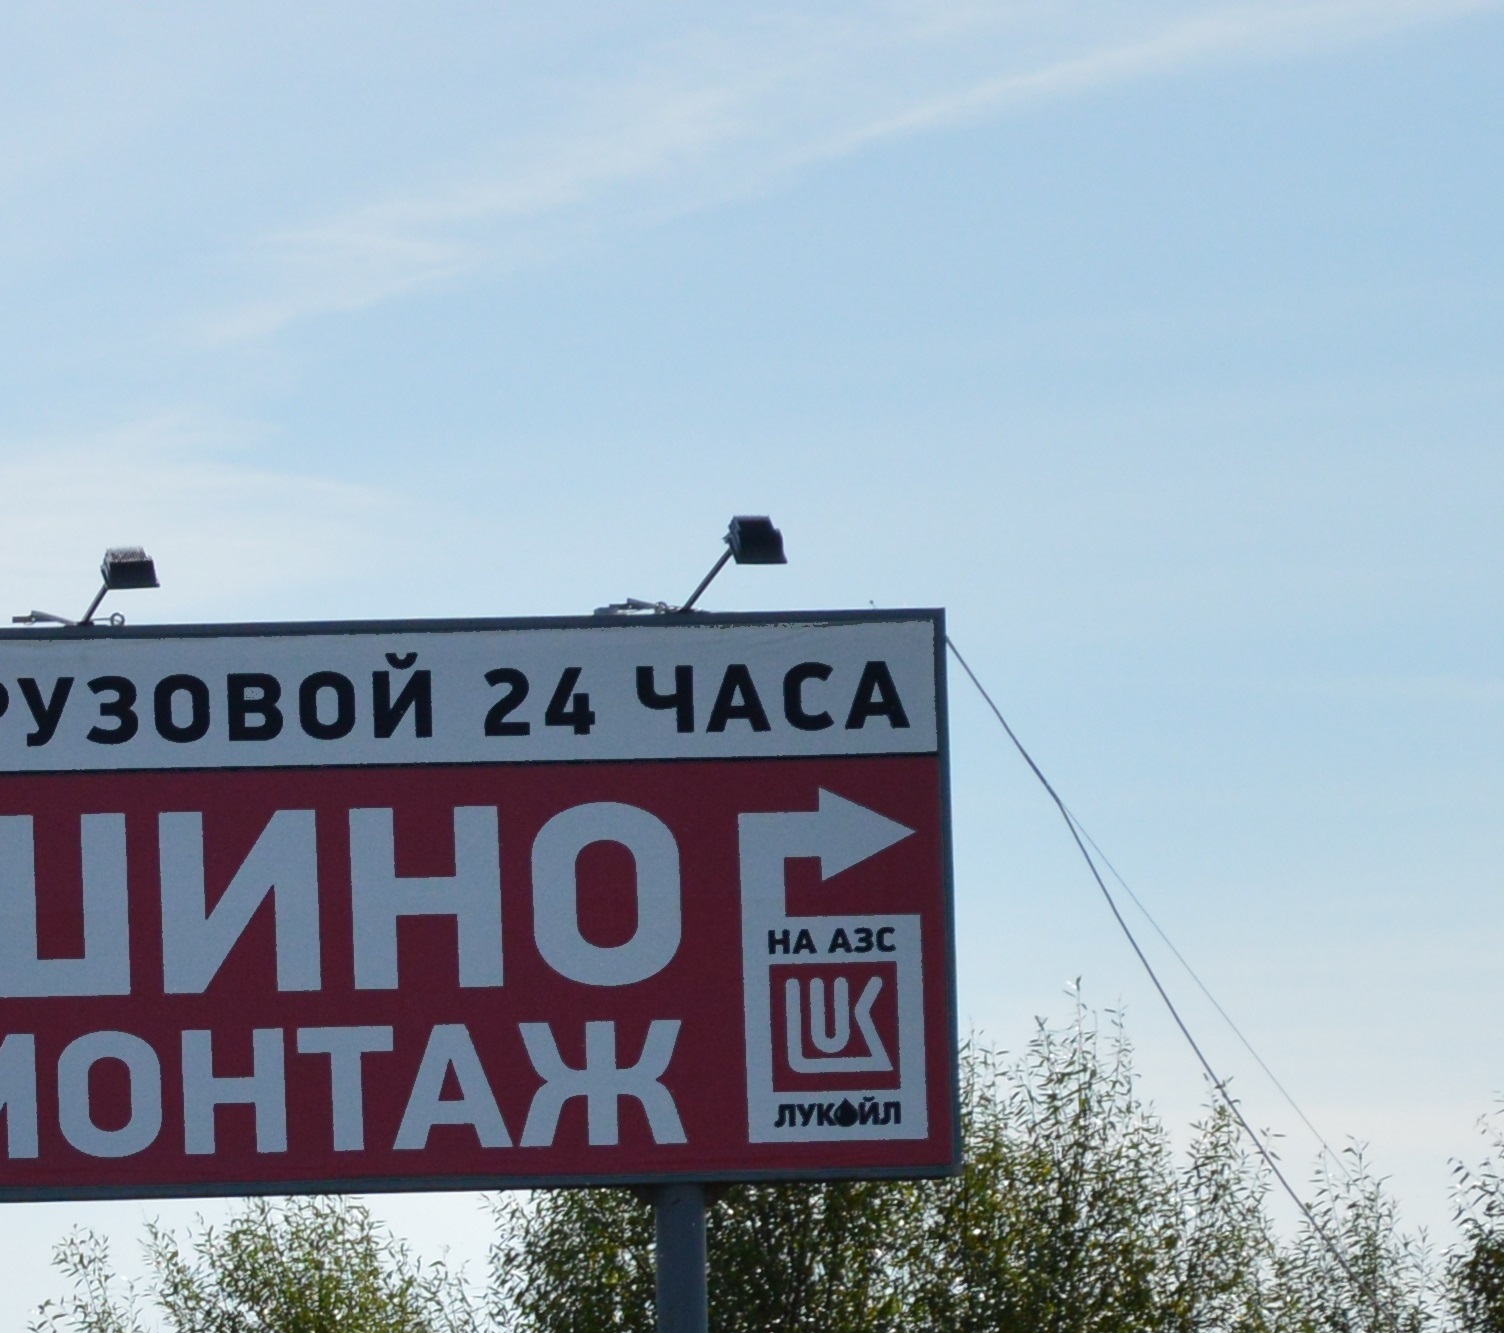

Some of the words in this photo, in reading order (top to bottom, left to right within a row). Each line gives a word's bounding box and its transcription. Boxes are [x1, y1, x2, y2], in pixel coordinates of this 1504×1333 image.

[484, 665, 596, 738] 24
[635, 660, 910, 735] ЧАСА
[767, 929, 817, 955] НА
[828, 926, 896, 954] АЗС
